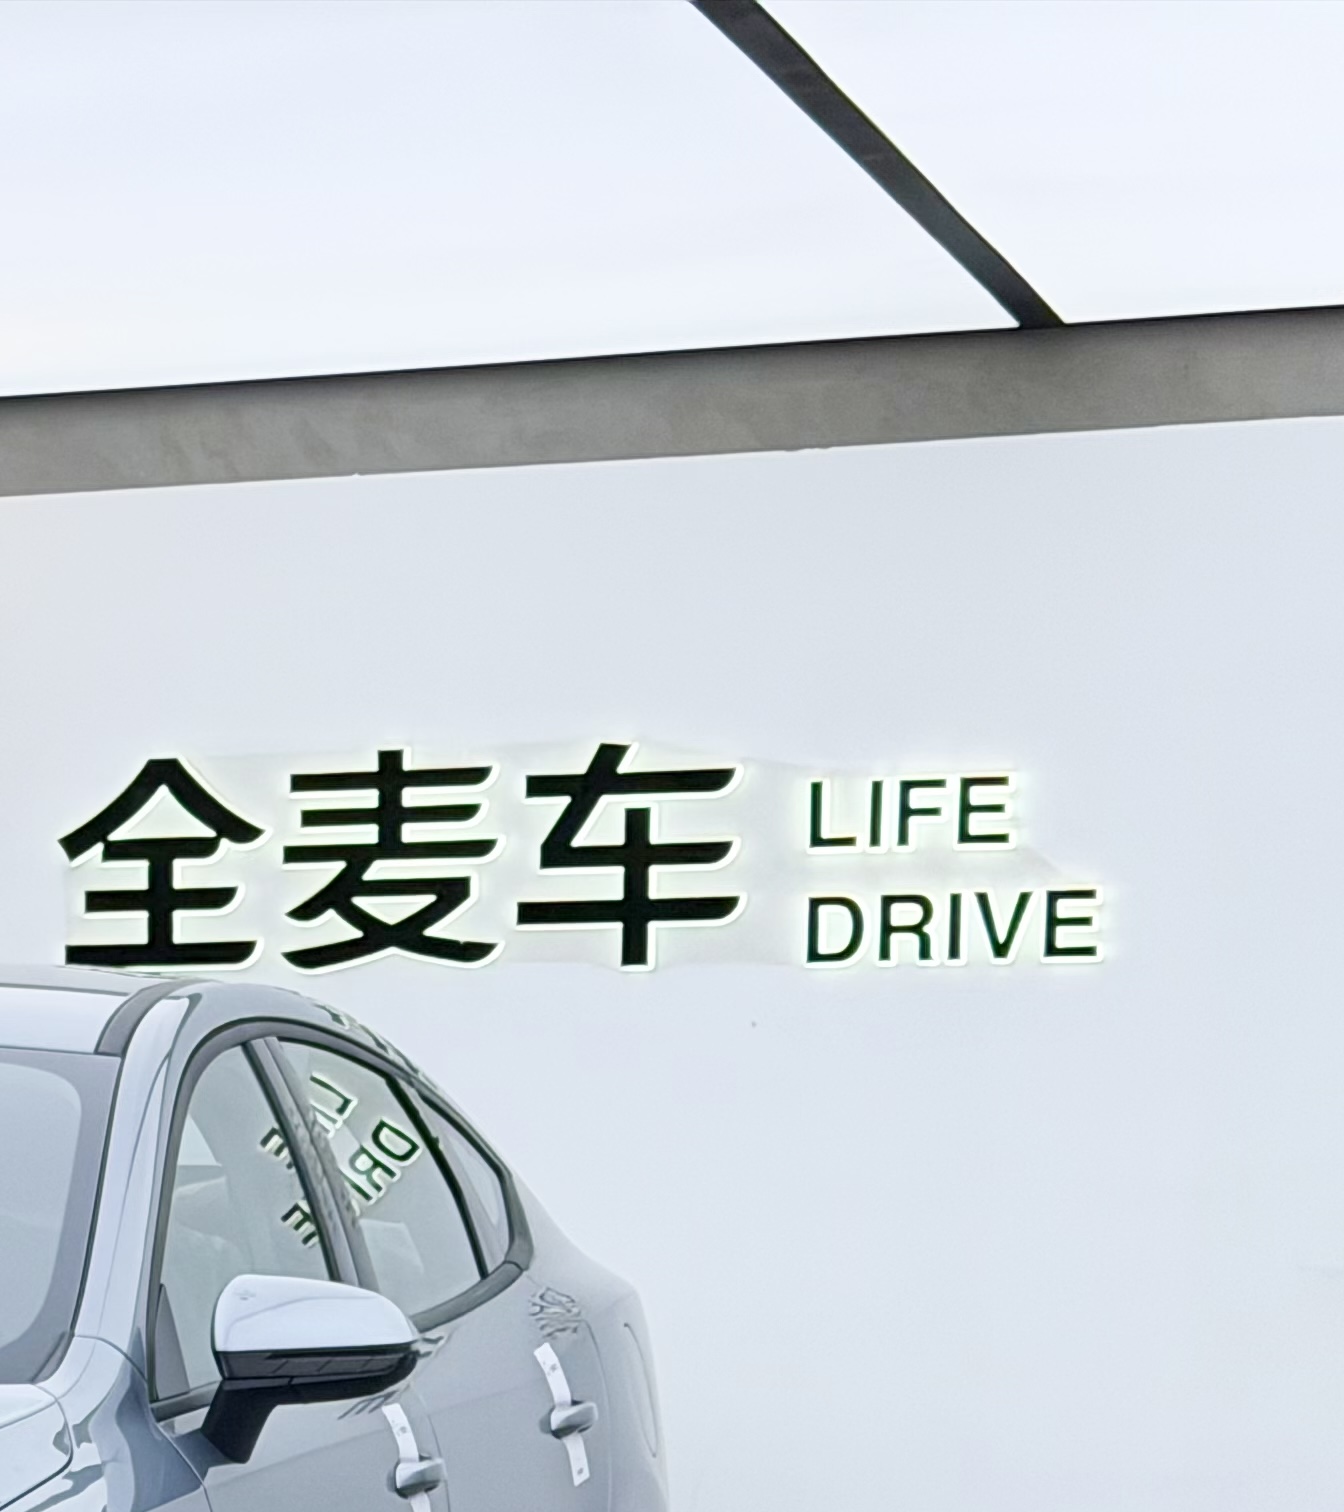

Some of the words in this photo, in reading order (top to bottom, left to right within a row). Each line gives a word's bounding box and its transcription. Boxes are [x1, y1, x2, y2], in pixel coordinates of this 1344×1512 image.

[808, 775, 1011, 848] LIFE
[58, 743, 740, 967] 全麦车
[806, 888, 1099, 963] DRIVE
